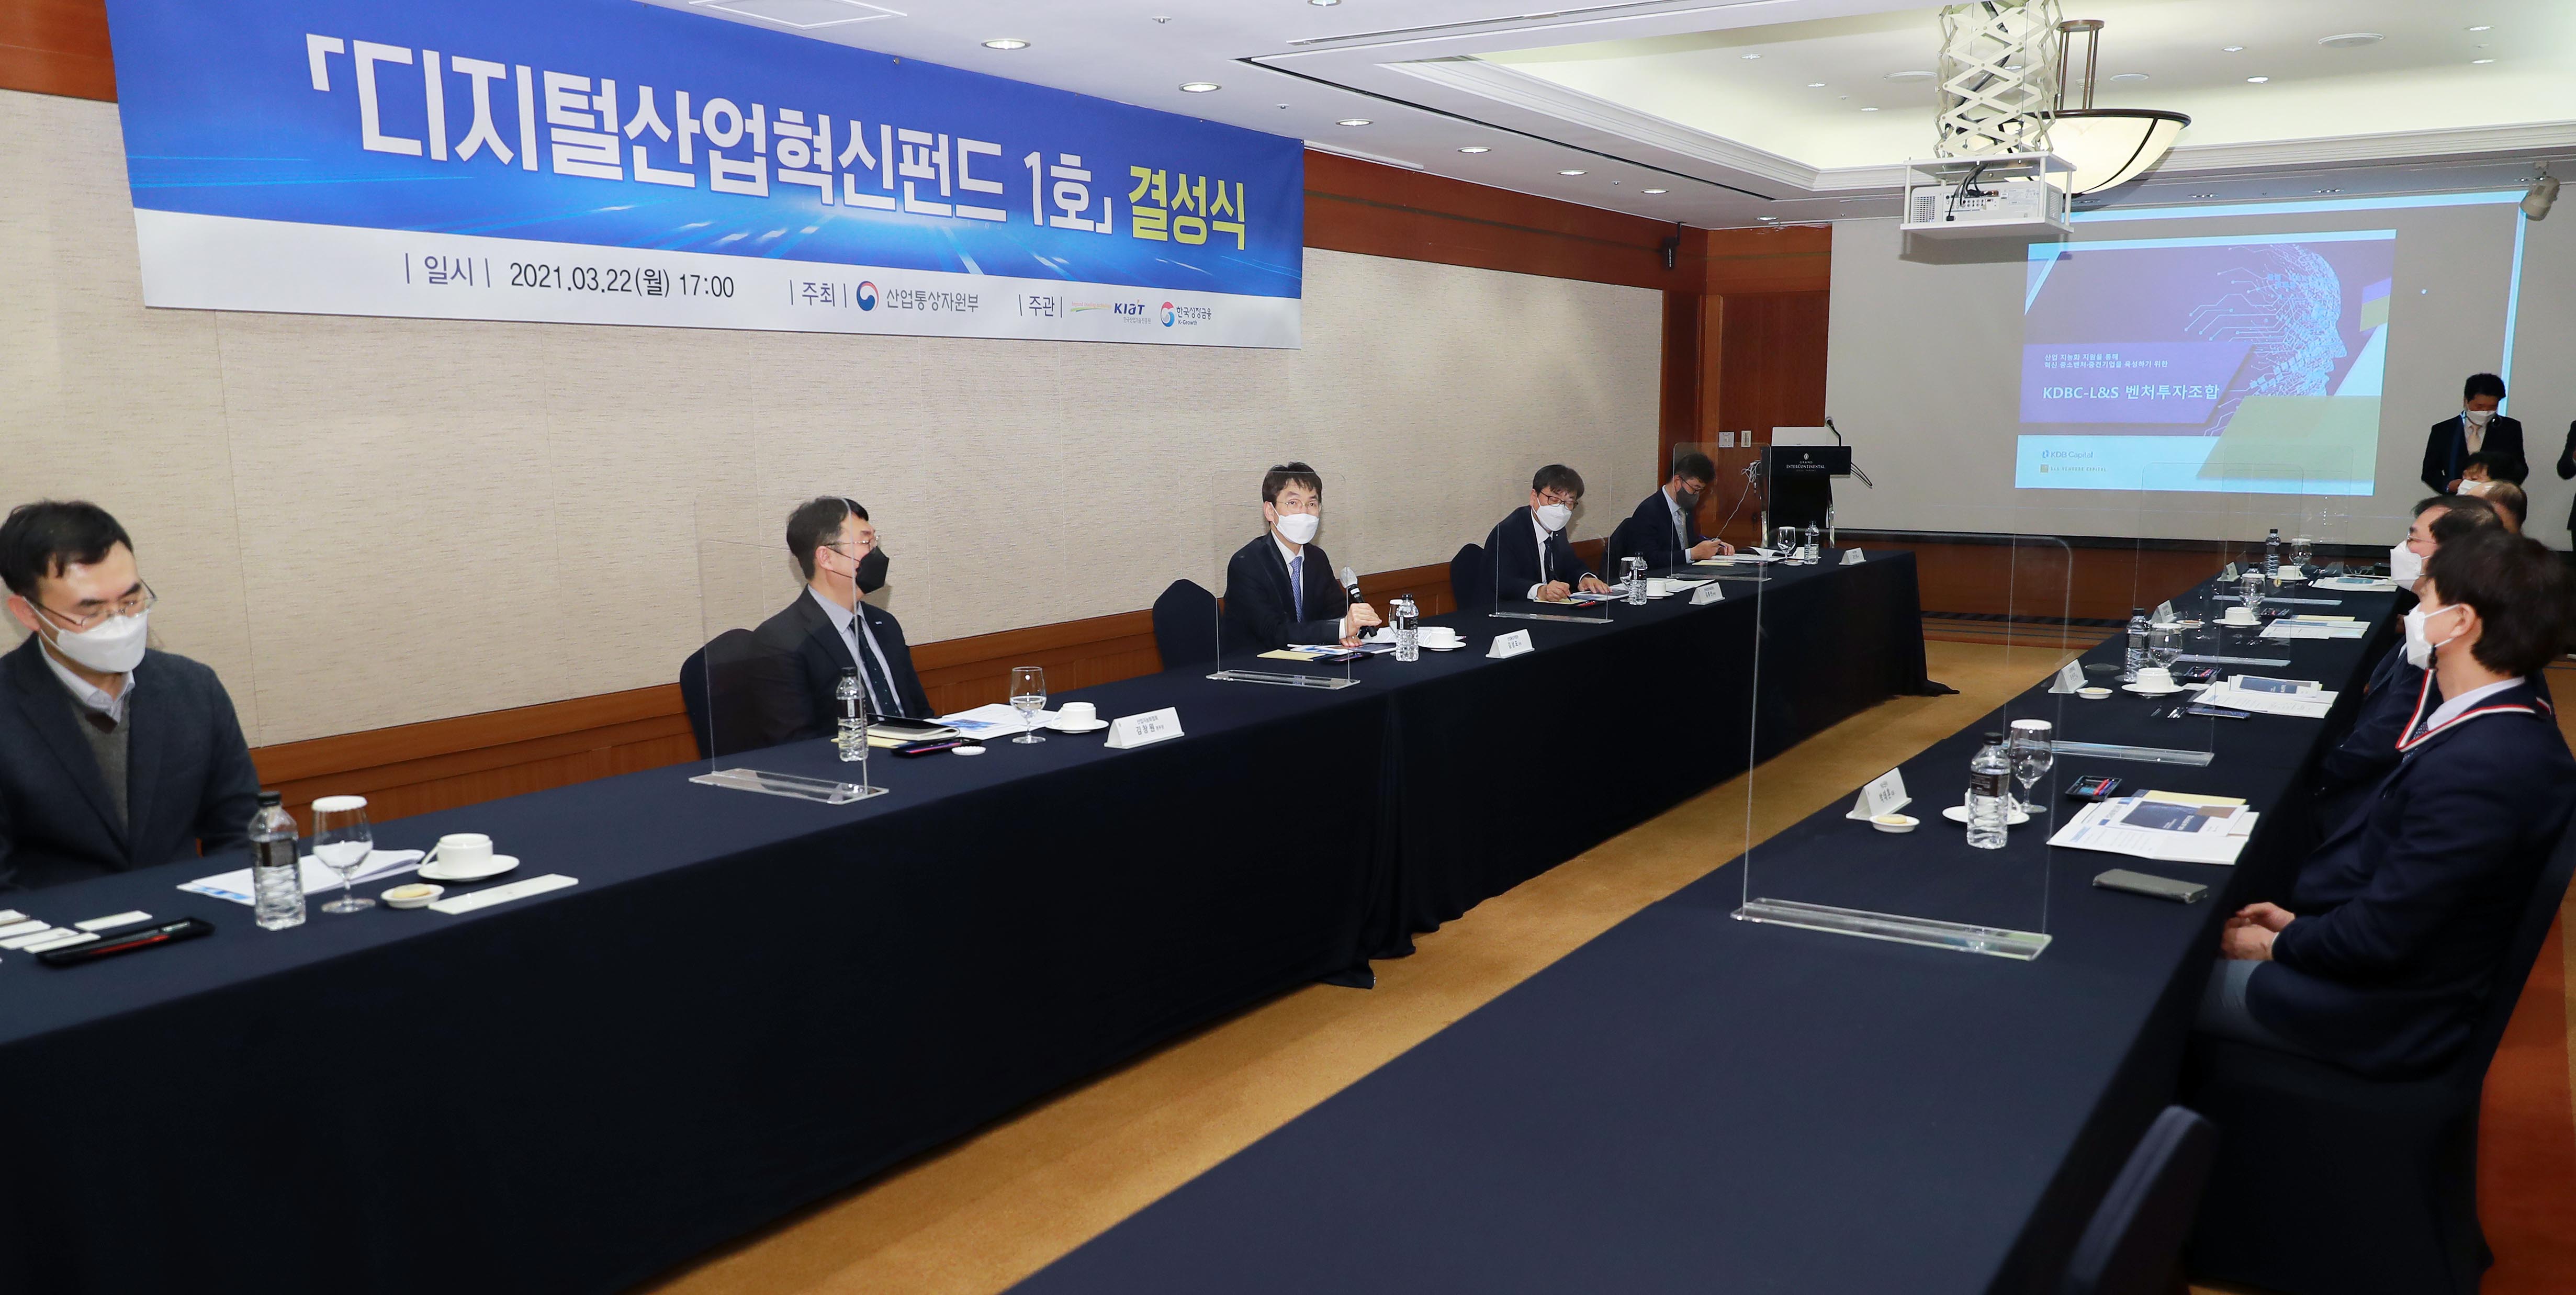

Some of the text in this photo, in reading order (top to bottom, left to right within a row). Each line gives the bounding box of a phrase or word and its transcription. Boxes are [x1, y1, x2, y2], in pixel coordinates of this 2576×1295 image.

[306, 33, 1246, 251] 「디지털산업혁신펀드 1호」 결성식
[510, 263, 670, 297] 2021.03.22(월)
[680, 274, 734, 298] 17:00
[886, 288, 979, 313] 산업통상자원부
[1176, 306, 1212, 320] 한국성장금융
[2042, 384, 2220, 400] KDBC-L&S 벤처투자조합
